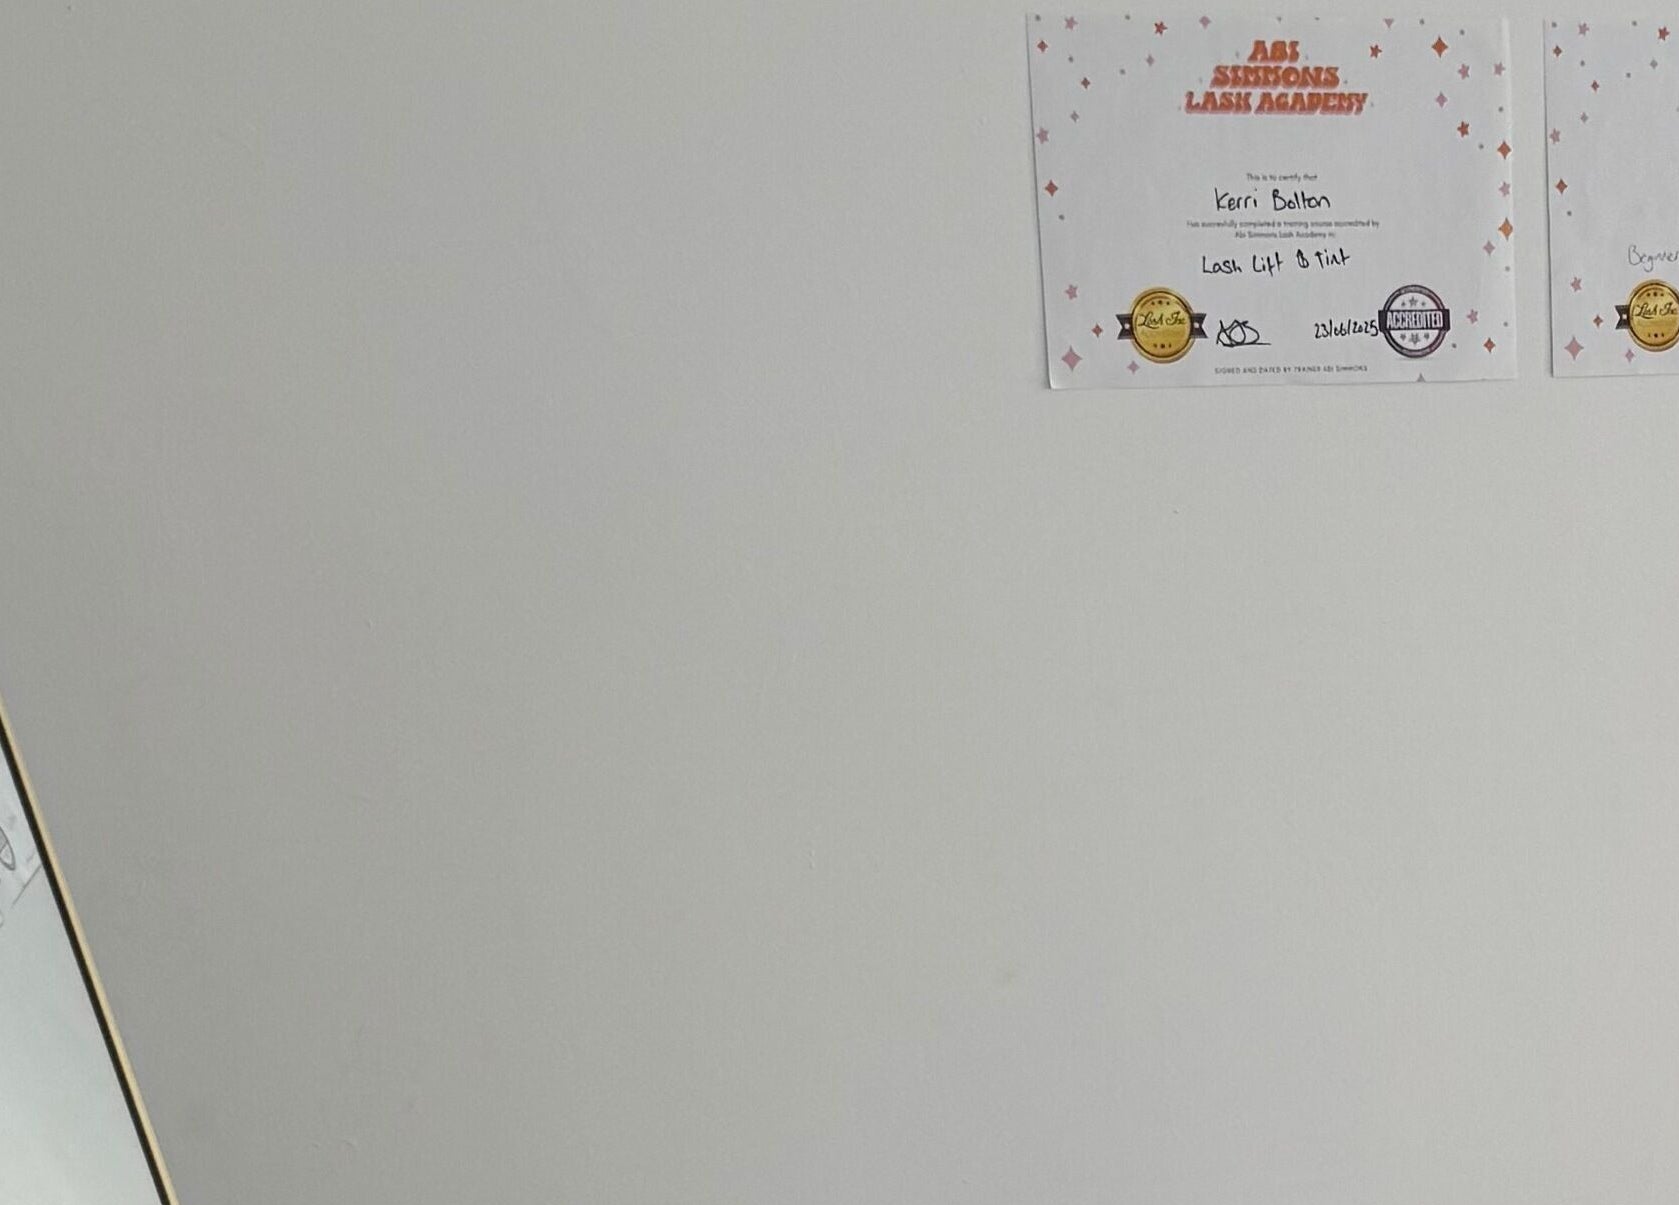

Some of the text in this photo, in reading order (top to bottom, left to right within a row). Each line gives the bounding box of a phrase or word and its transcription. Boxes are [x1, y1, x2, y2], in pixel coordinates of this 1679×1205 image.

[1247, 39, 1300, 63] ABI
[1209, 65, 1341, 89] SIMMONS
[1183, 91, 1369, 115] LASH ACADEMY
[1214, 187, 1331, 211] Kerri Bolton
[1202, 255, 1242, 274] Lash
[1252, 251, 1283, 277] Lift
[1314, 248, 1350, 269] Tint
[1386, 310, 1444, 329] ACCREDITED
